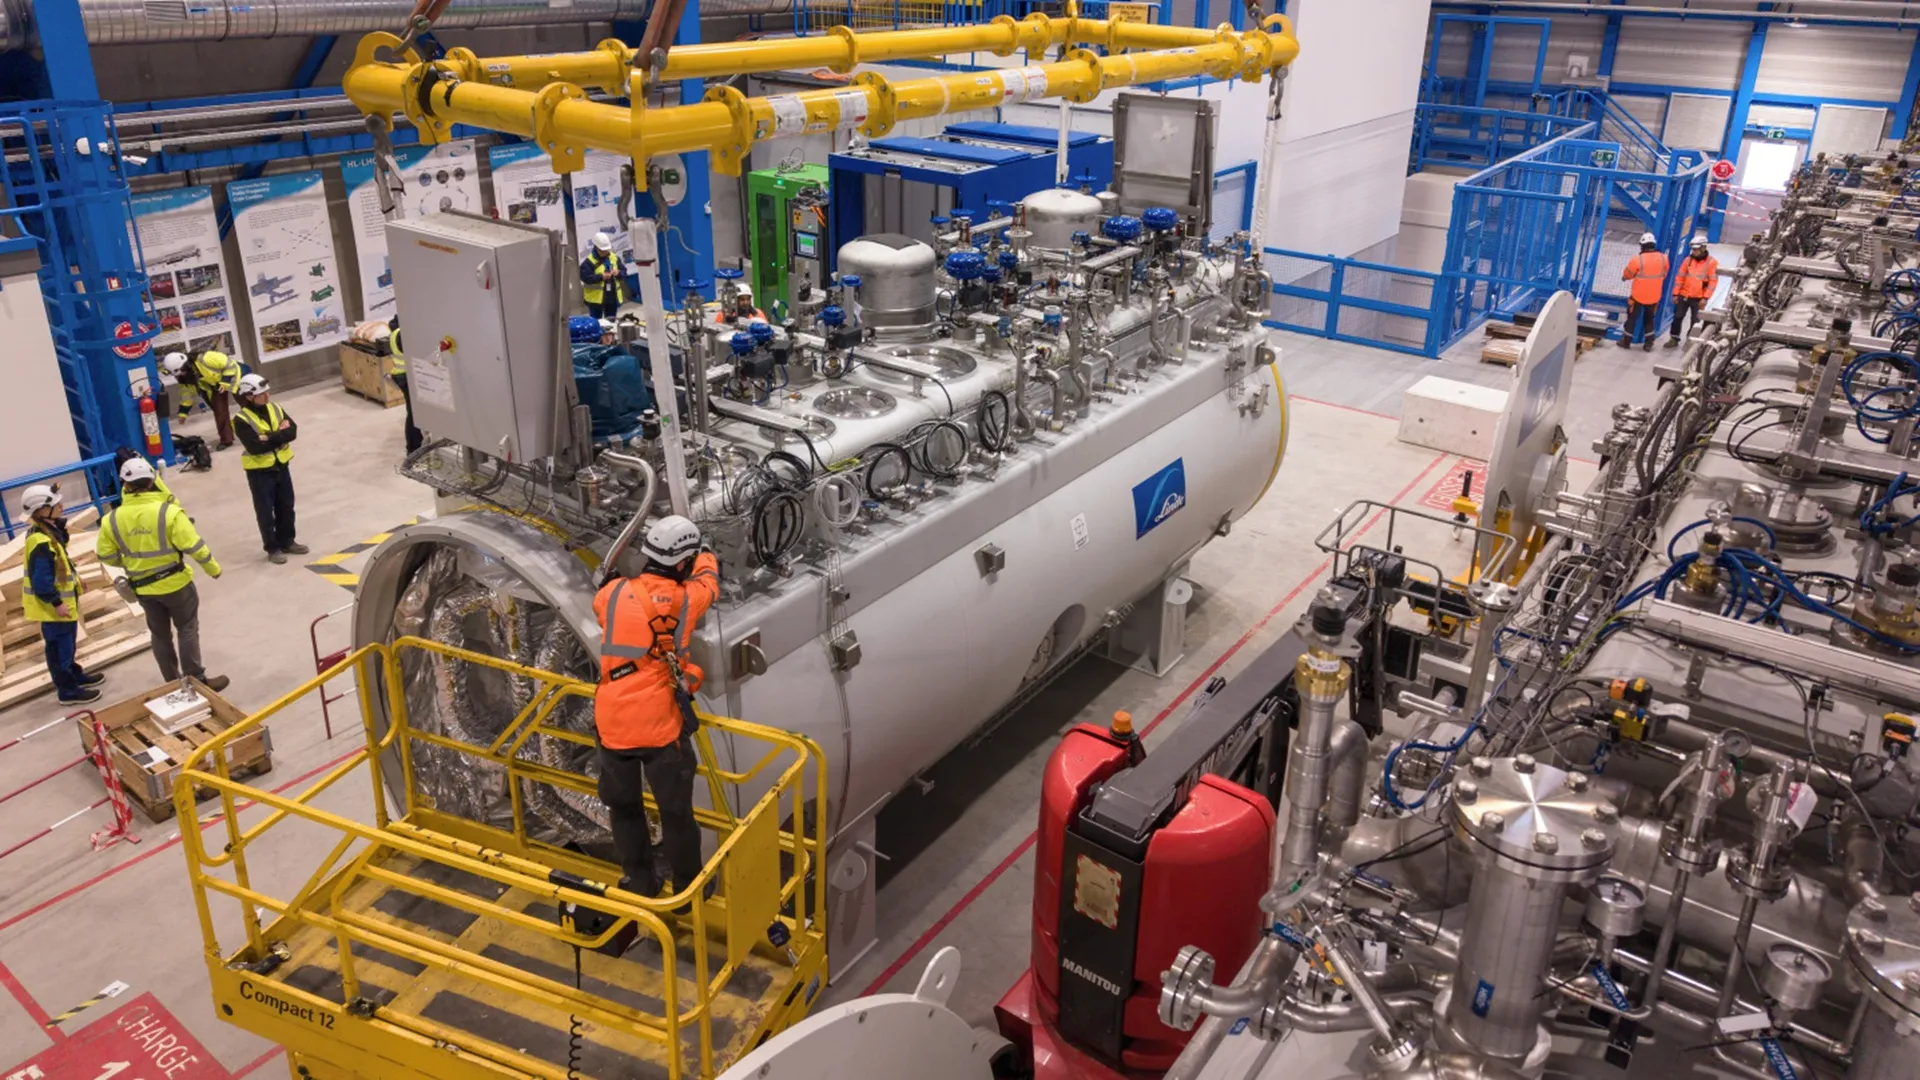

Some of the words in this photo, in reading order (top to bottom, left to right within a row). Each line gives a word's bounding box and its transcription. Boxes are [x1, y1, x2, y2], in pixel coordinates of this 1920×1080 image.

[1153, 492, 1185, 523] Linde
[1062, 957, 1122, 996] MANITOU
[240, 980, 314, 1023] Compact
[319, 1012, 335, 1030] 12
[117, 1005, 199, 1080] CHARGE
